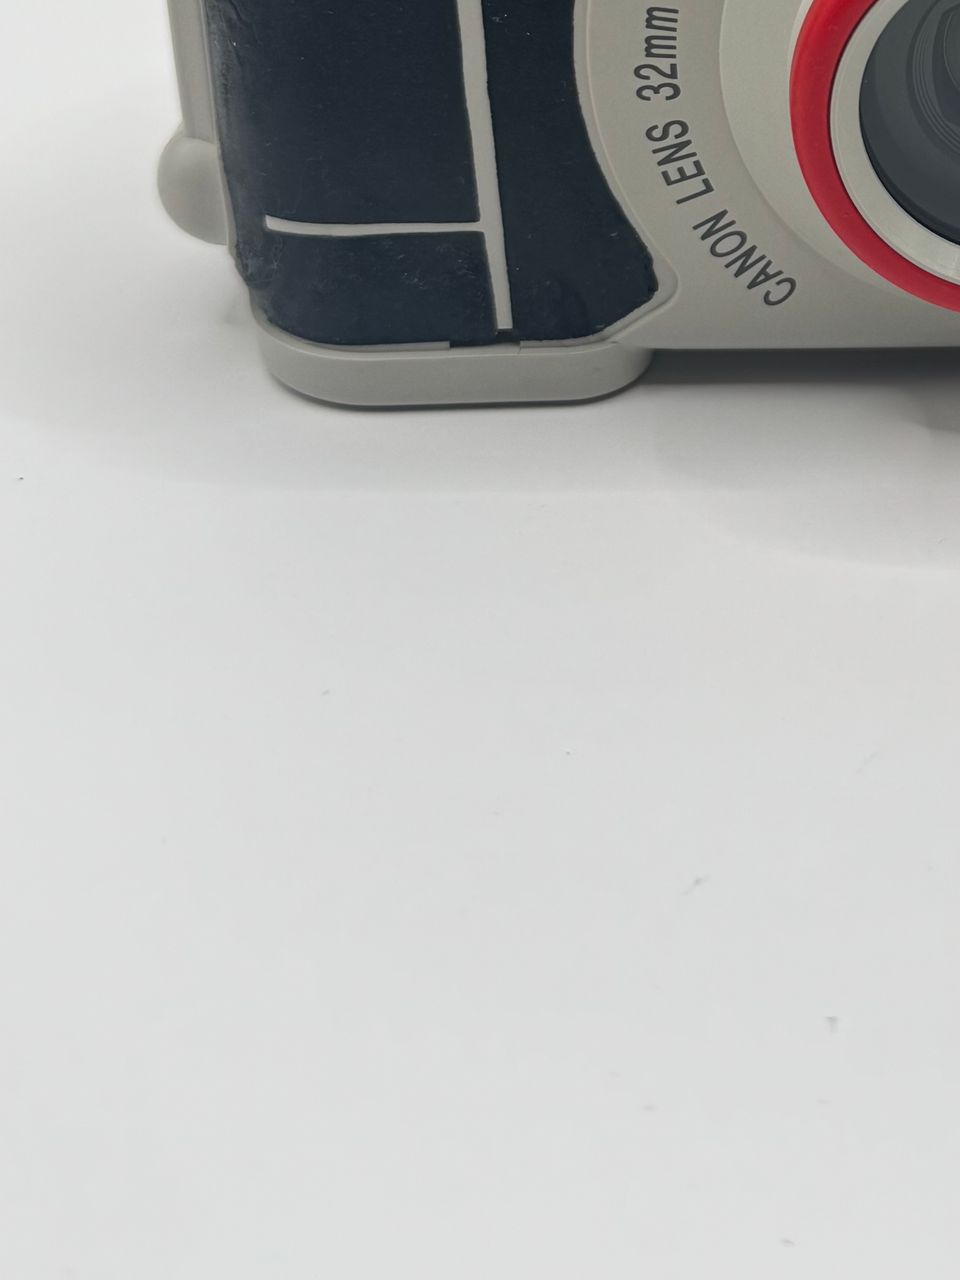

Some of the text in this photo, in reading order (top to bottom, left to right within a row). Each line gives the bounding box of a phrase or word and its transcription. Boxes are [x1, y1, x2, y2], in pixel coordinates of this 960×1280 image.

[633, 6, 682, 102] 32mm
[645, 119, 715, 205] LENS
[691, 209, 798, 307] CANON
